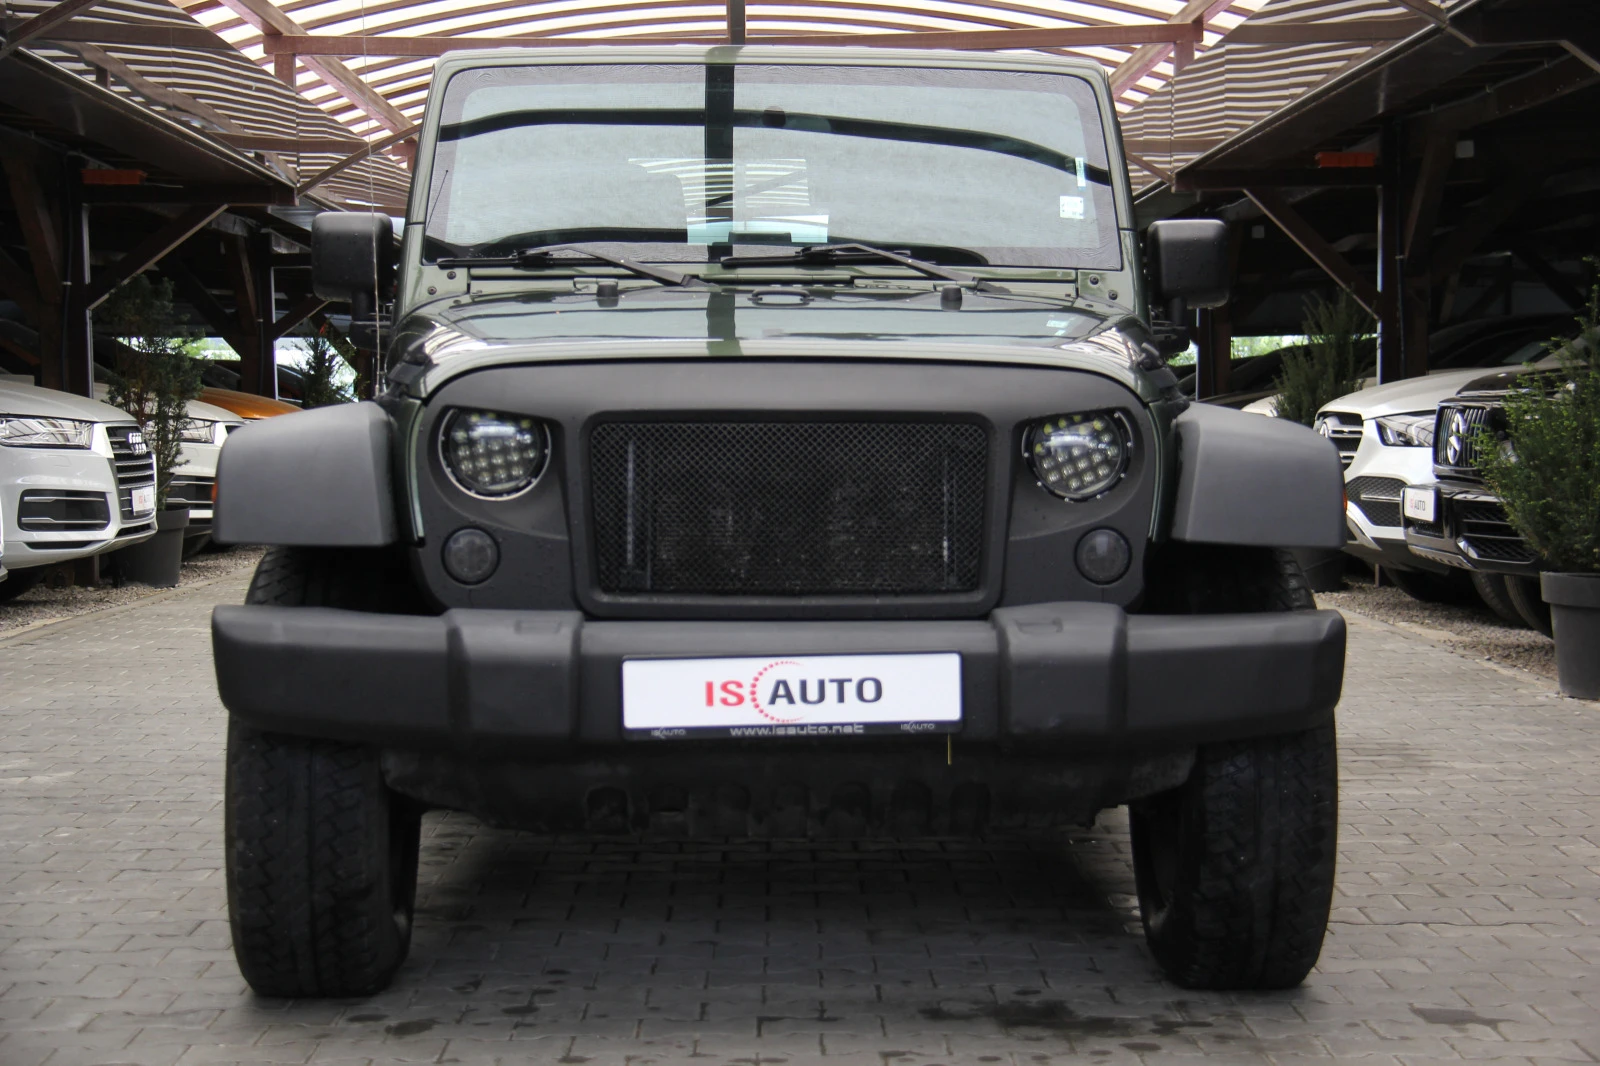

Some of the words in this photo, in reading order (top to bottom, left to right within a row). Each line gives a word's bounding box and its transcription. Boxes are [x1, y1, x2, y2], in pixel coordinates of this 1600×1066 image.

[705, 680, 745, 707] IS
[768, 676, 883, 705] AUTO
[730, 723, 865, 737] www.isauto.net
